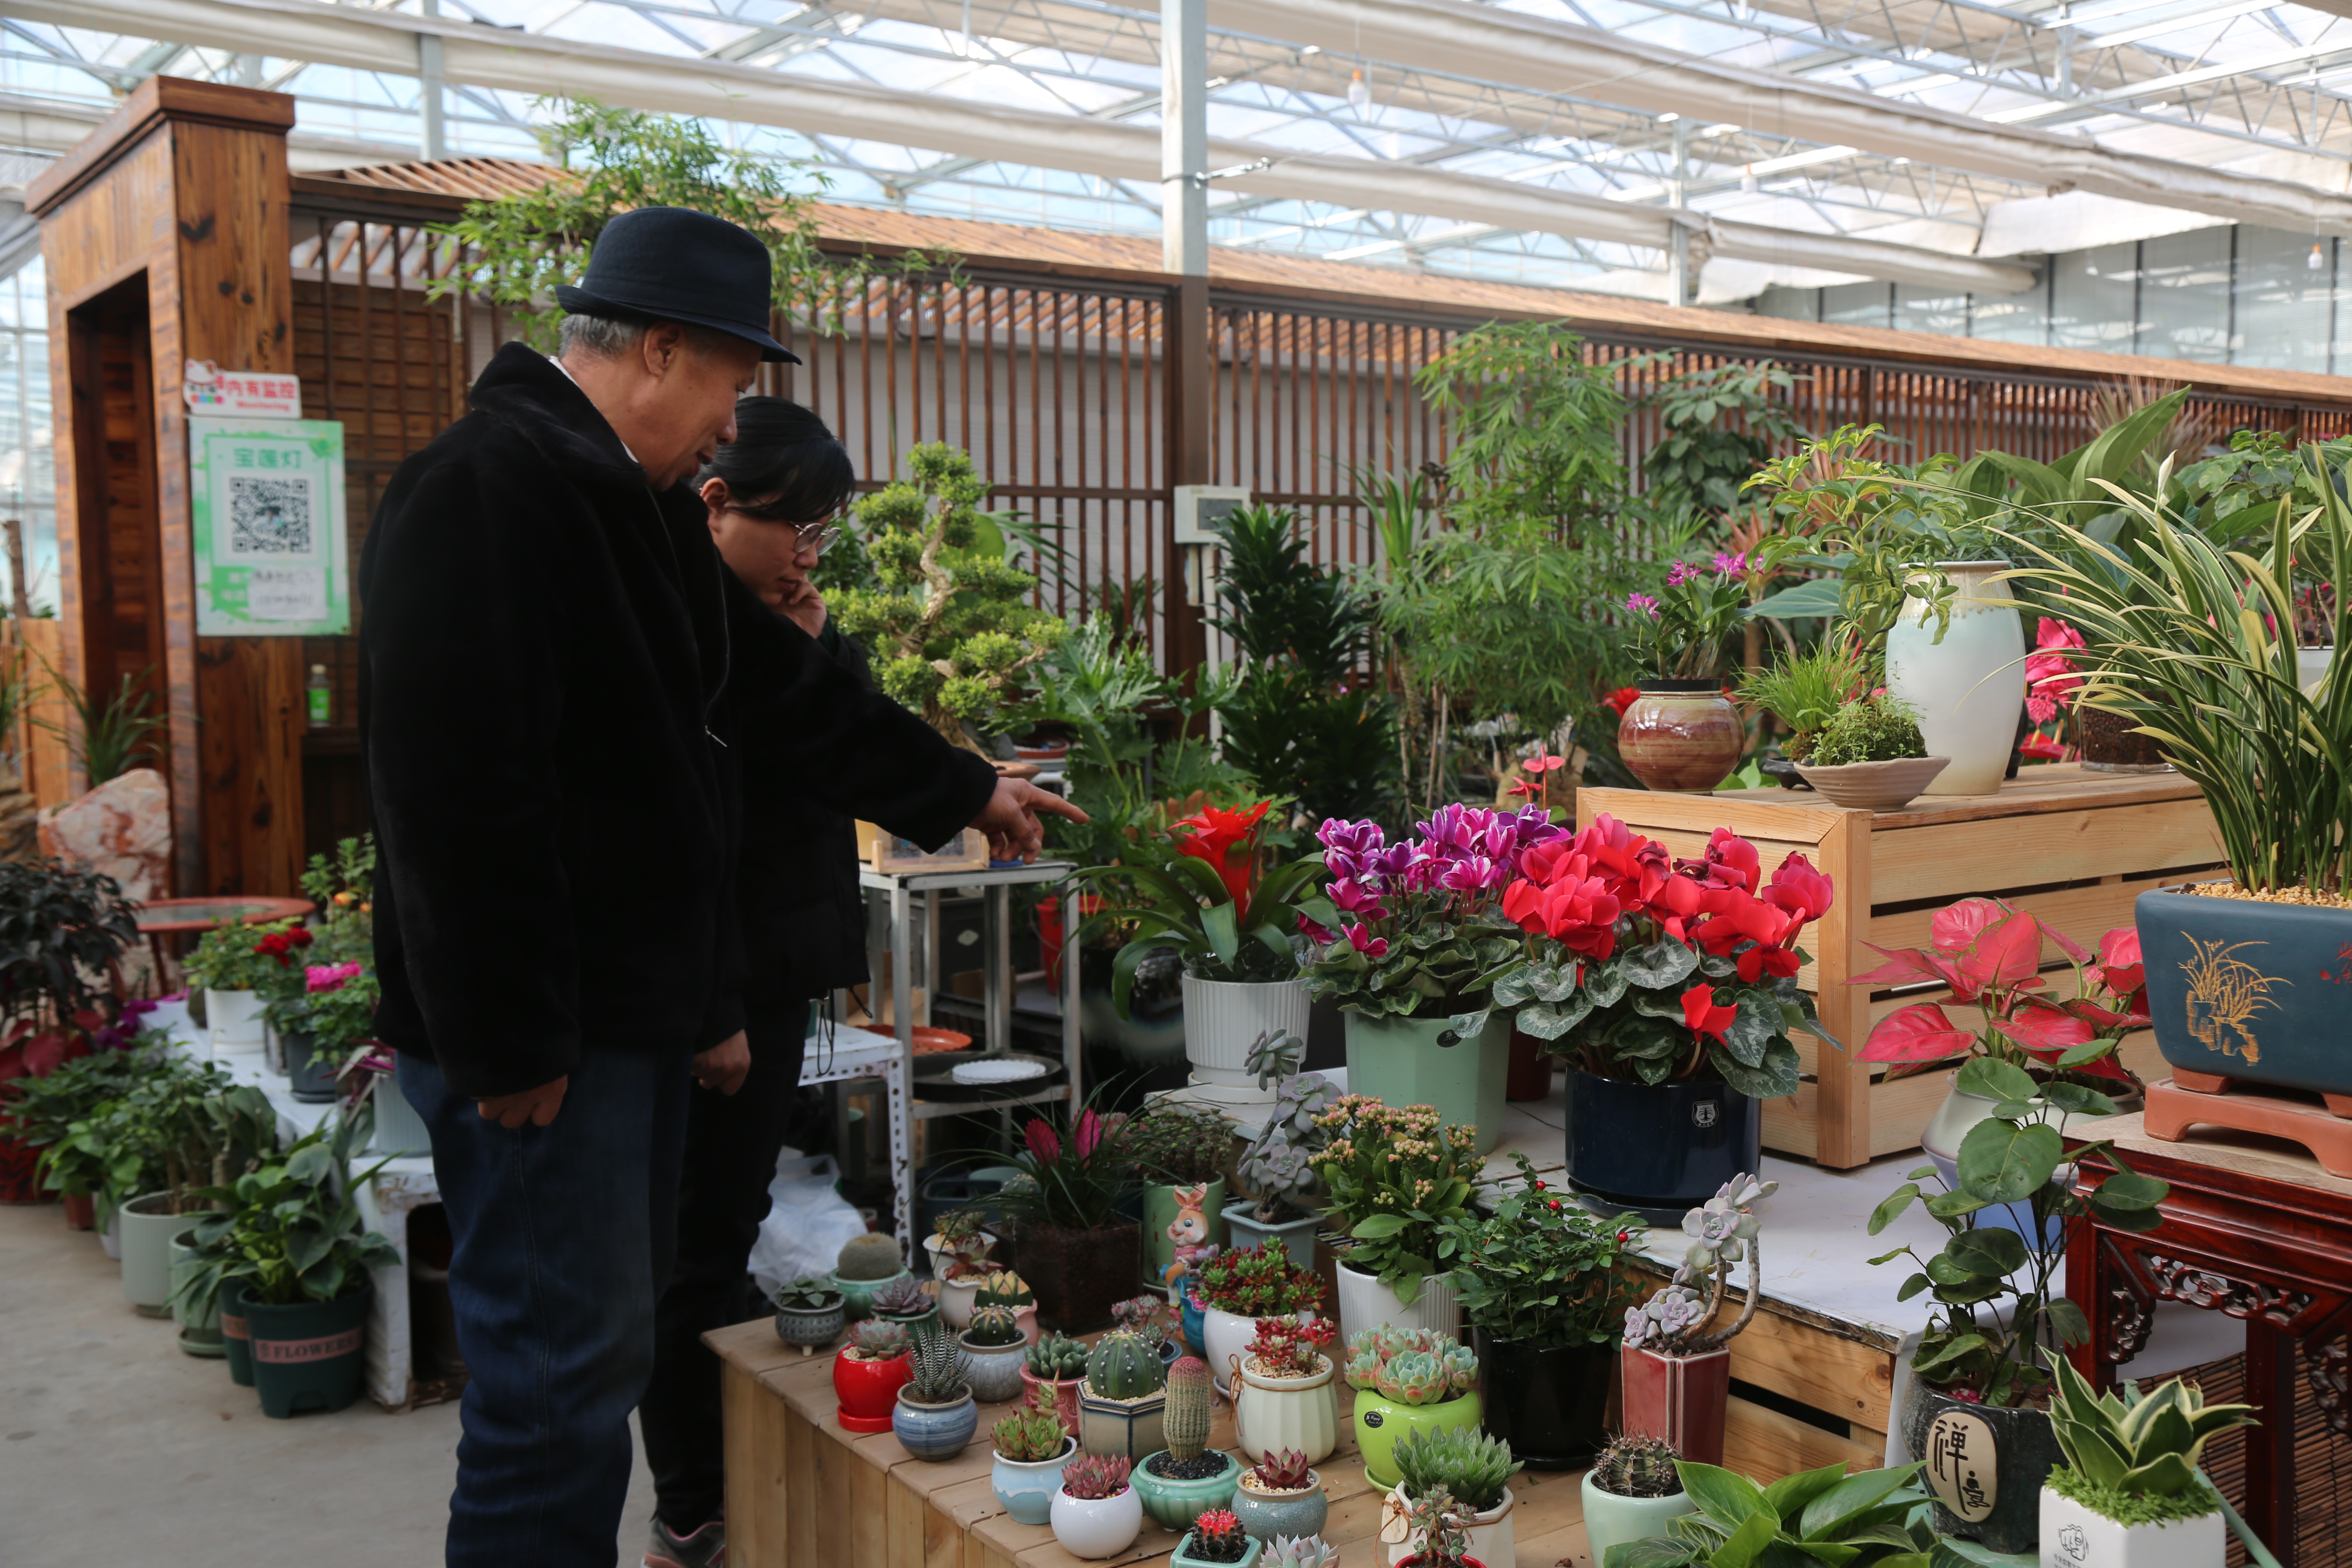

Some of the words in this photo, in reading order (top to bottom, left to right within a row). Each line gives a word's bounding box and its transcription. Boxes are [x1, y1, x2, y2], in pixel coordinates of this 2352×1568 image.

[227, 379, 296, 399] 内有监控
[236, 401, 290, 412] Monitoring
[234, 448, 303, 469] 宝莲灯
[273, 1335, 354, 1359] FLOWERS
[1933, 1419, 1971, 1516] 禅
